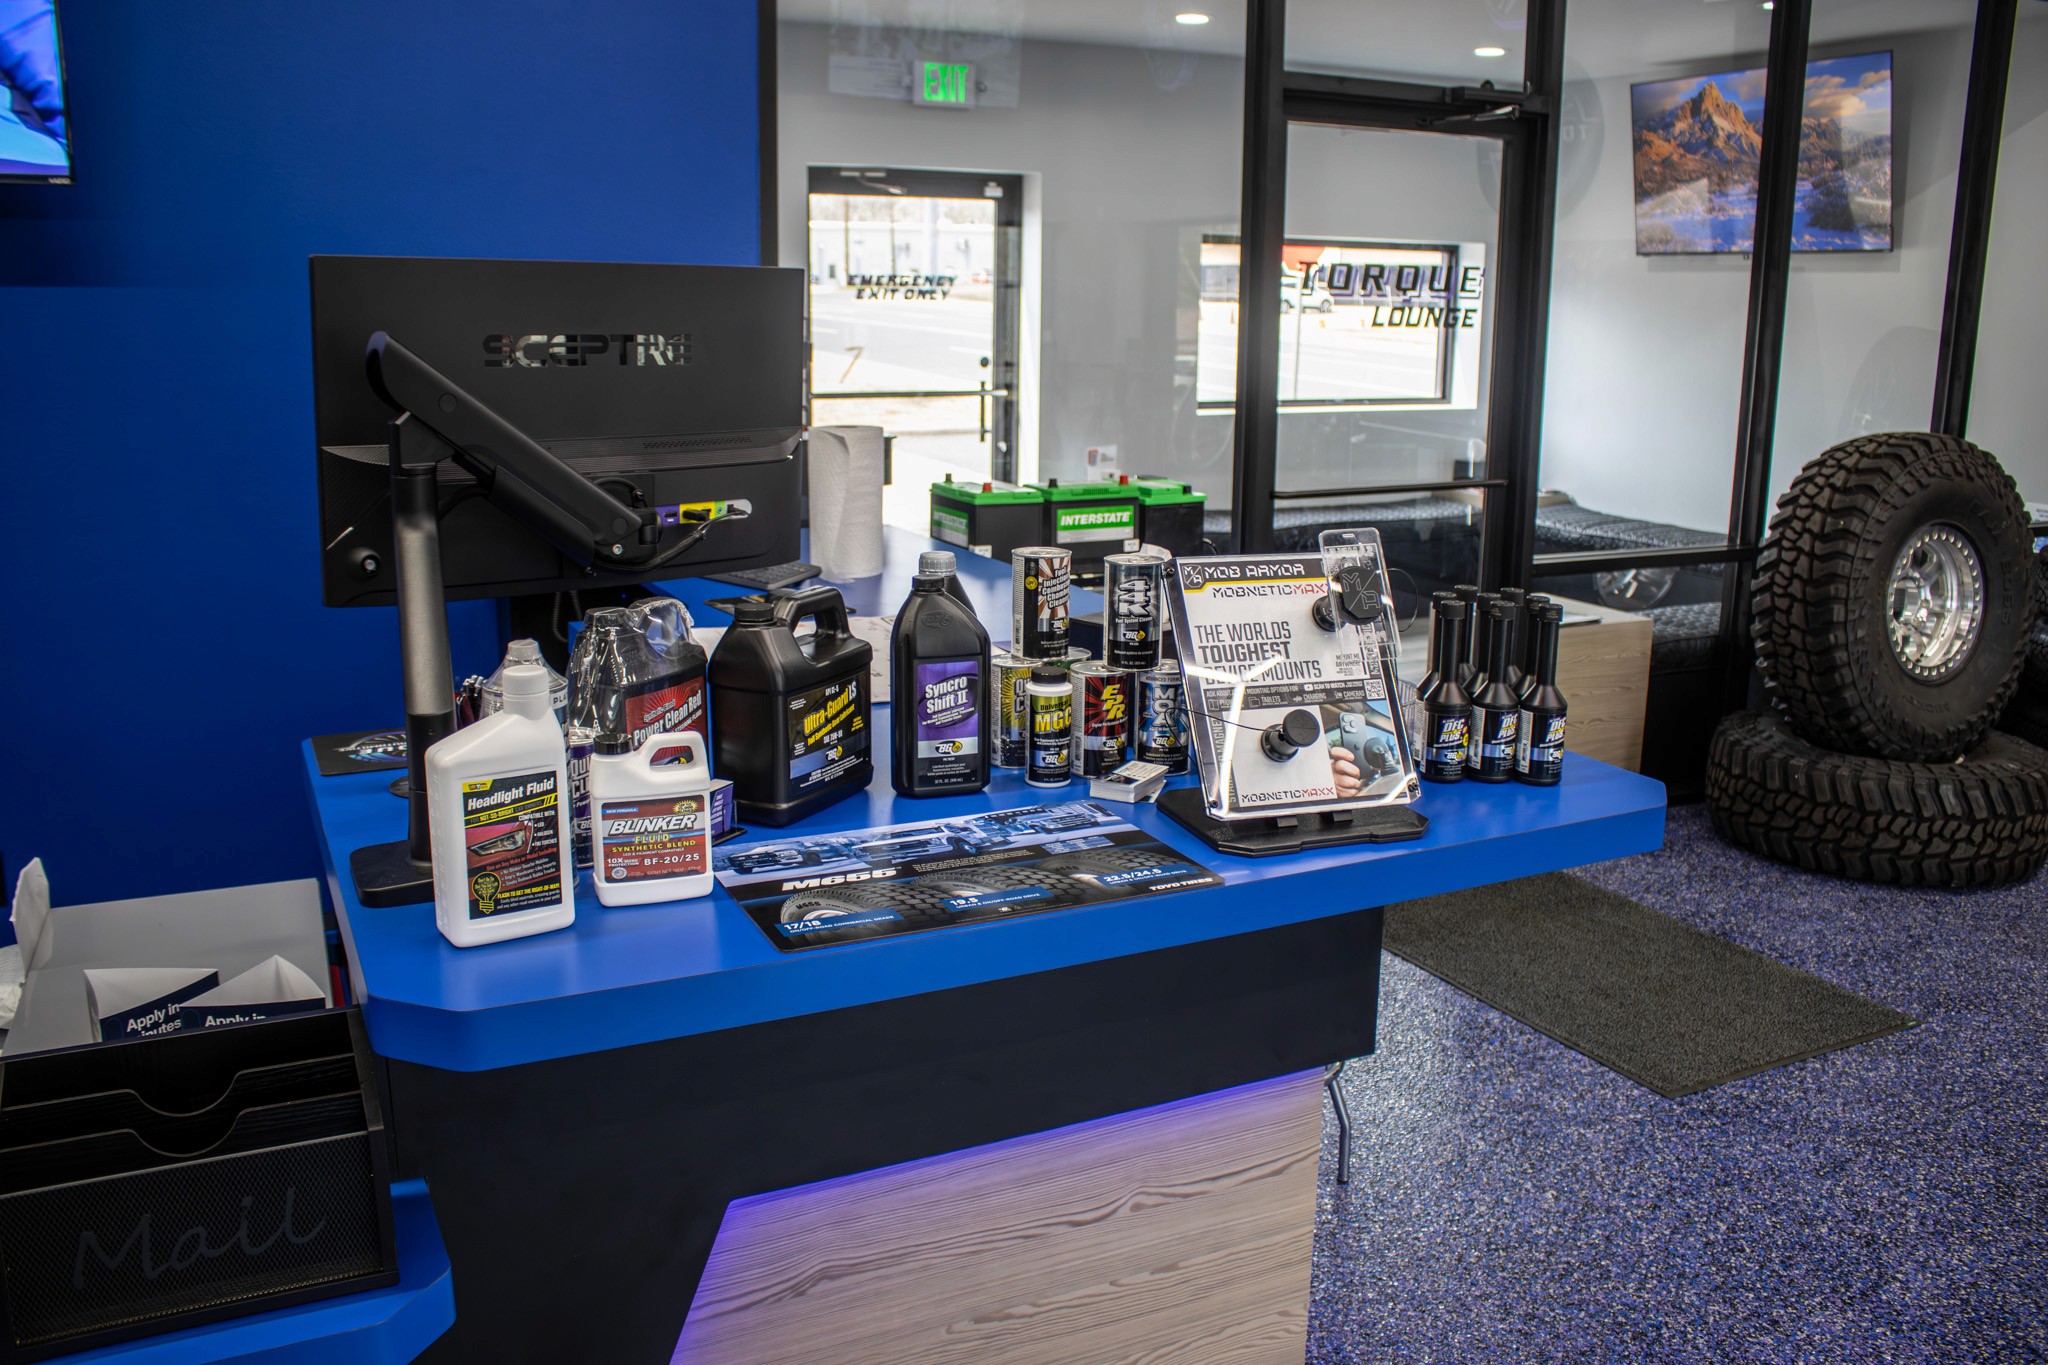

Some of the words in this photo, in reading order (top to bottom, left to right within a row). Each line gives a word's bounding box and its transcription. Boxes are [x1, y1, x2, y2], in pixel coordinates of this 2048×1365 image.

[924, 62, 968, 103] EXIT
[847, 275, 957, 286] EMERGENCY
[1298, 261, 1484, 300] TORQUE
[856, 288, 898, 300] EXIT
[904, 289, 950, 300] ONLY
[1372, 306, 1477, 328] LOUNGE
[482, 334, 693, 368] SCEPTRE
[1060, 511, 1131, 527] INTERSTATE
[1204, 565, 1241, 580] MOB
[1246, 563, 1306, 578] ARMOR
[1194, 624, 1223, 644] THE
[1226, 621, 1291, 643] WORLDS
[1198, 641, 1290, 665] TOUGHEST
[1261, 660, 1322, 682] MOUNTS
[848, 681, 857, 701] LS
[925, 676, 968, 699] Syncro
[926, 694, 956, 714] Shift
[1101, 684, 1126, 720] EPR
[1152, 687, 1177, 727] MOA
[665, 702, 688, 729] Clean
[1034, 706, 1072, 733] MGC
[467, 786, 524, 811] Headlight
[526, 776, 555, 796] Fluid
[1241, 786, 1335, 804] MOBNETICMAXX
[608, 814, 697, 836] BLINKER
[612, 843, 663, 853] SYNTHETIC
[666, 840, 696, 848] BLEND
[634, 833, 670, 844] FLUID
[644, 853, 700, 866] BF-20/25
[782, 867, 897, 892] M655
[1103, 868, 1162, 882] 22.5/24.5
[1149, 882, 1180, 892] TOYO
[1180, 877, 1214, 887] TIRES
[950, 897, 979, 906] 19.5
[833, 918, 873, 927] COMMERCIAL
[126, 1008, 166, 1033] Apply
[168, 1003, 181, 1016] in
[72, 1186, 326, 1290] Mail
